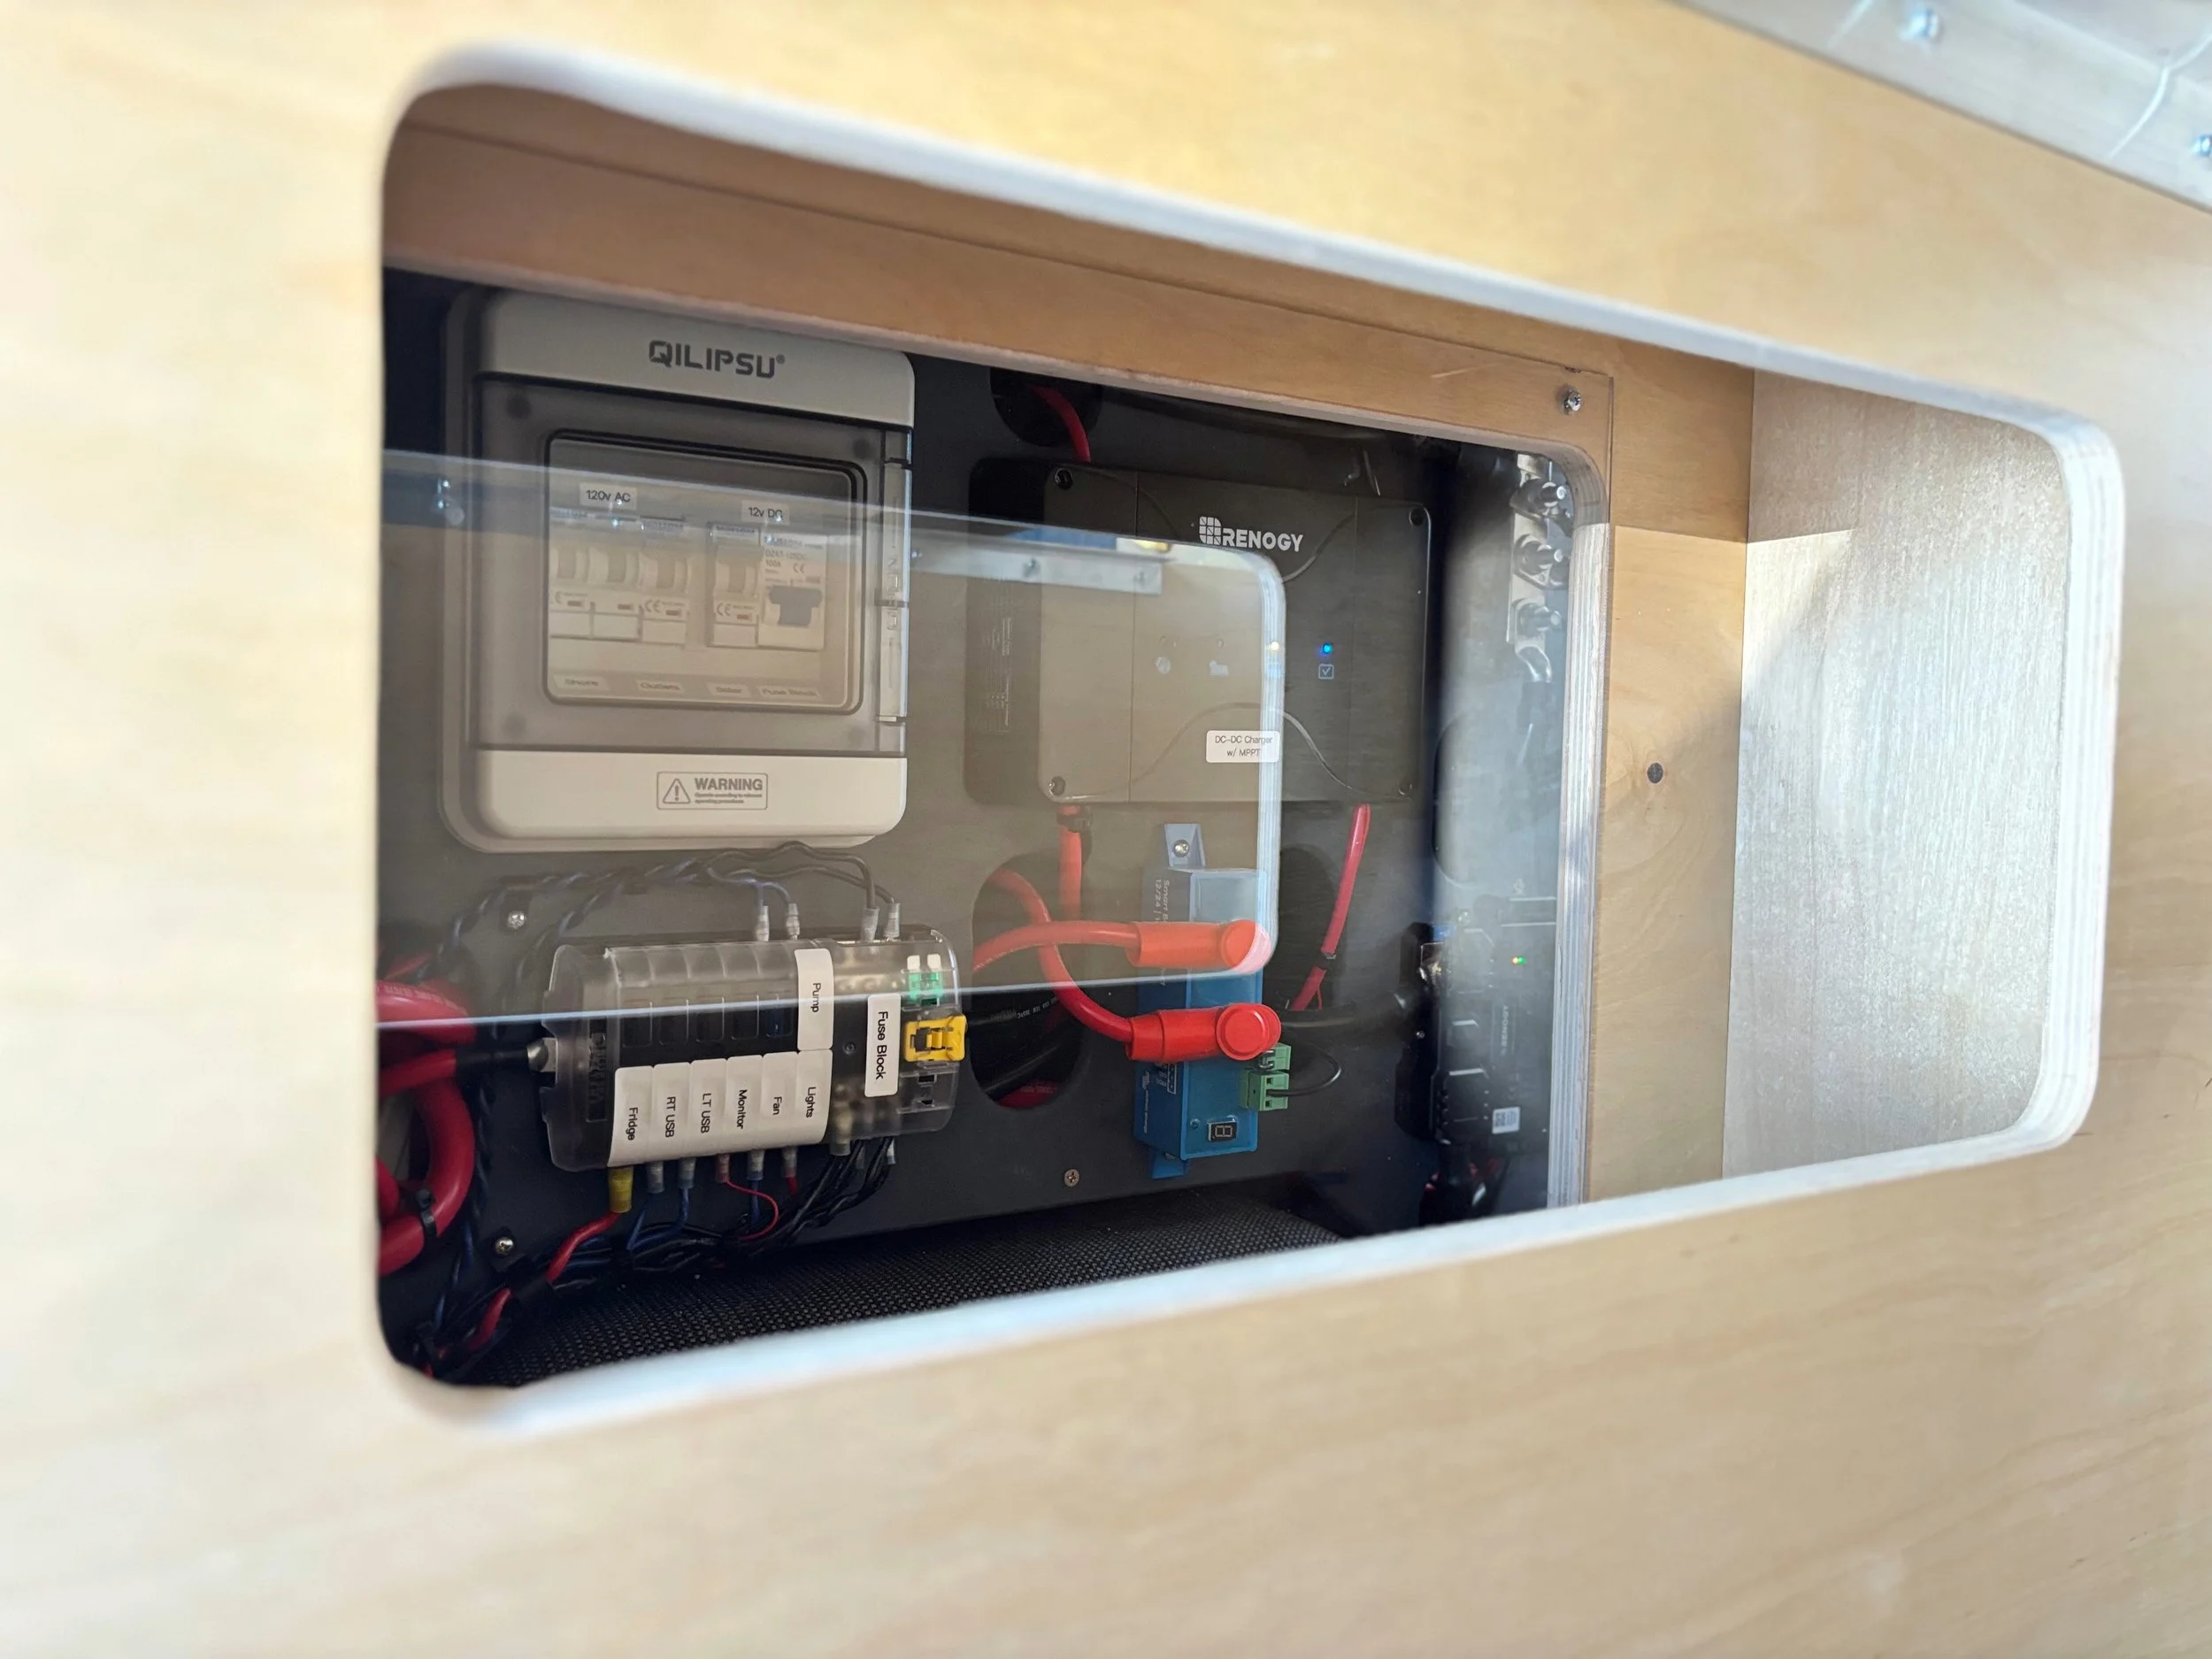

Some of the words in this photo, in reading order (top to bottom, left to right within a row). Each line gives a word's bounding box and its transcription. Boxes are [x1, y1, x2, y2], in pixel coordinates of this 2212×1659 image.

[586, 489, 611, 502] 120v
[614, 492, 631, 503] AC
[748, 506, 764, 518] 12v
[767, 509, 784, 520] DC
[1222, 527, 1304, 552] RENOGY
[1215, 735, 1243, 744] DC-DC
[1244, 735, 1273, 746] Charger
[1226, 748, 1237, 757] w/
[694, 777, 764, 791] WARNING
[810, 982, 821, 1013] Pump
[877, 1011, 888, 1041] Fuse
[875, 1044, 887, 1080] Block
[666, 1096, 676, 1111] RT
[702, 1093, 711, 1110] LT
[736, 1089, 748, 1130] Monitor
[772, 1096, 783, 1116] Fan
[805, 1087, 817, 1118] Lights
[626, 1107, 639, 1141] Fridge
[664, 1114, 675, 1138] USB
[700, 1111, 710, 1133] USB
